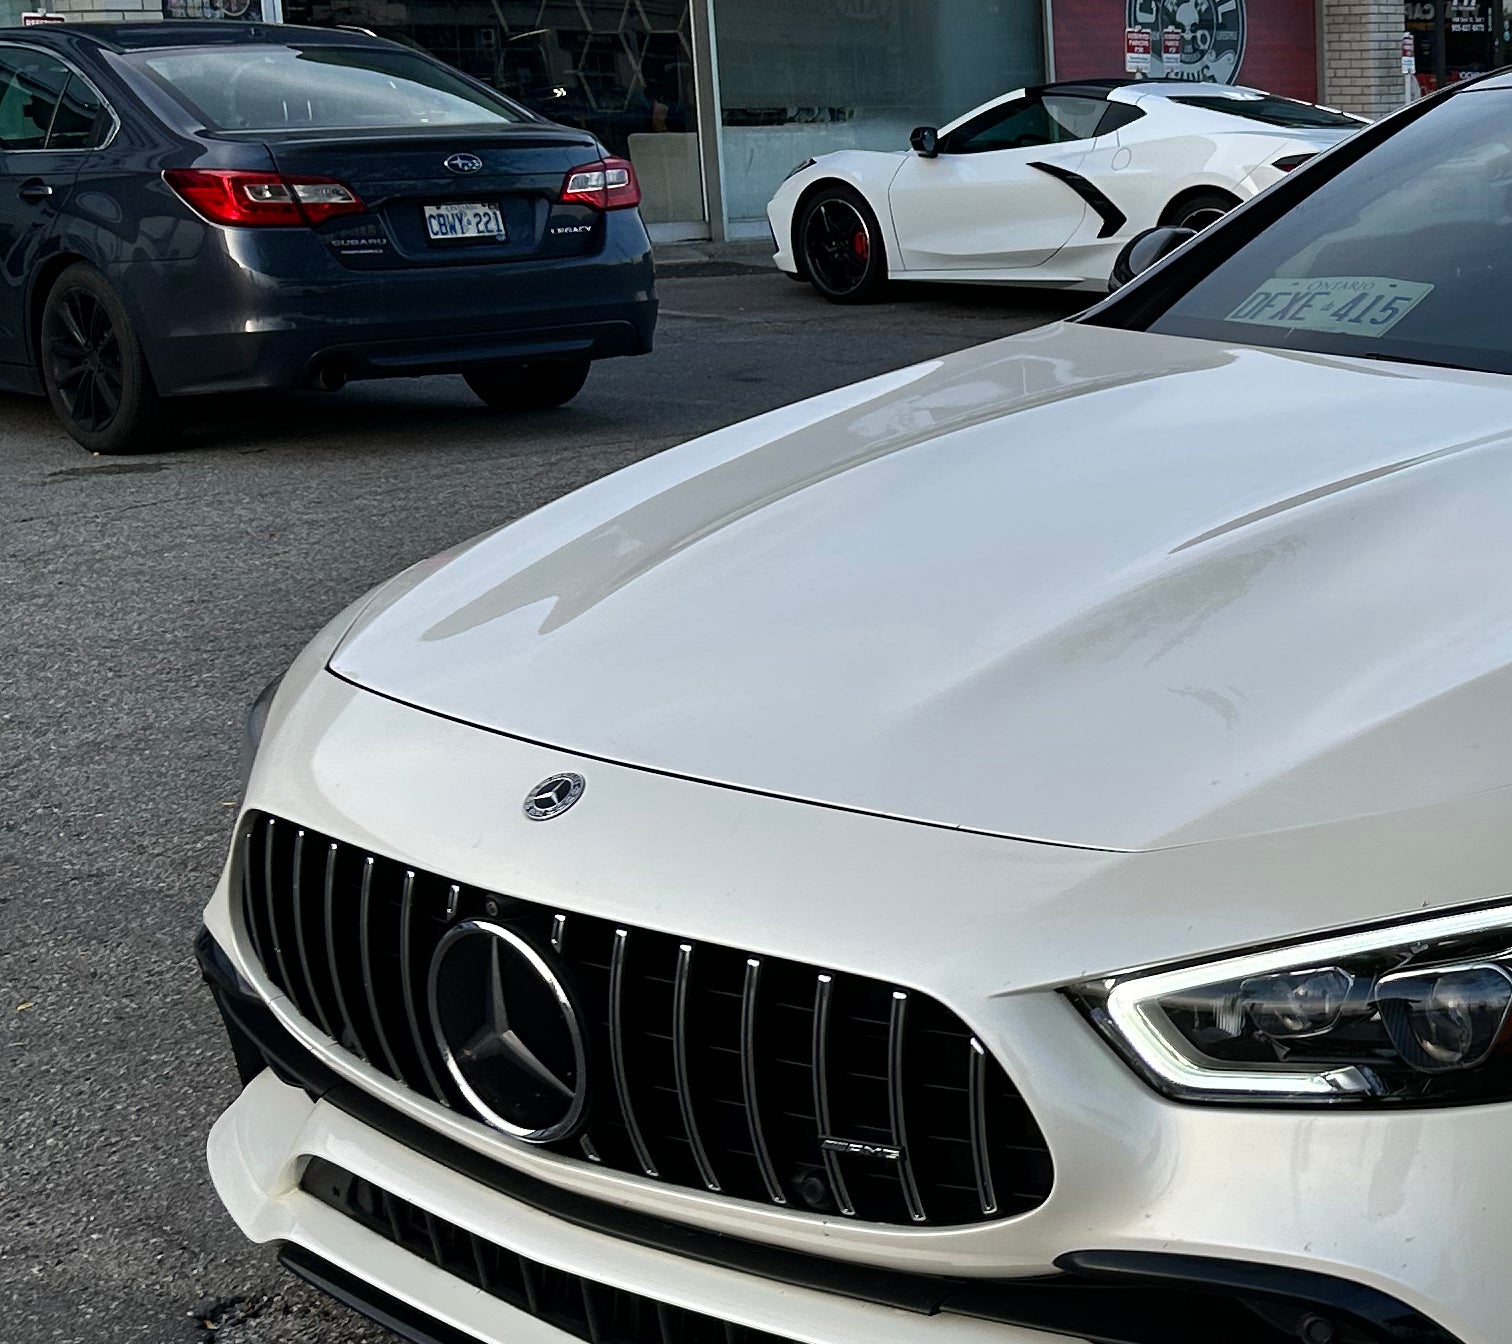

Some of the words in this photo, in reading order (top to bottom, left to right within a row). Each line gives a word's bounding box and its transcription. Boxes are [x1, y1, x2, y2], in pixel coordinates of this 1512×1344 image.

[473, 212, 502, 233] 221
[331, 239, 387, 247] SUBARU
[1307, 280, 1375, 292] ONTARIO
[1329, 292, 1413, 326] 415
